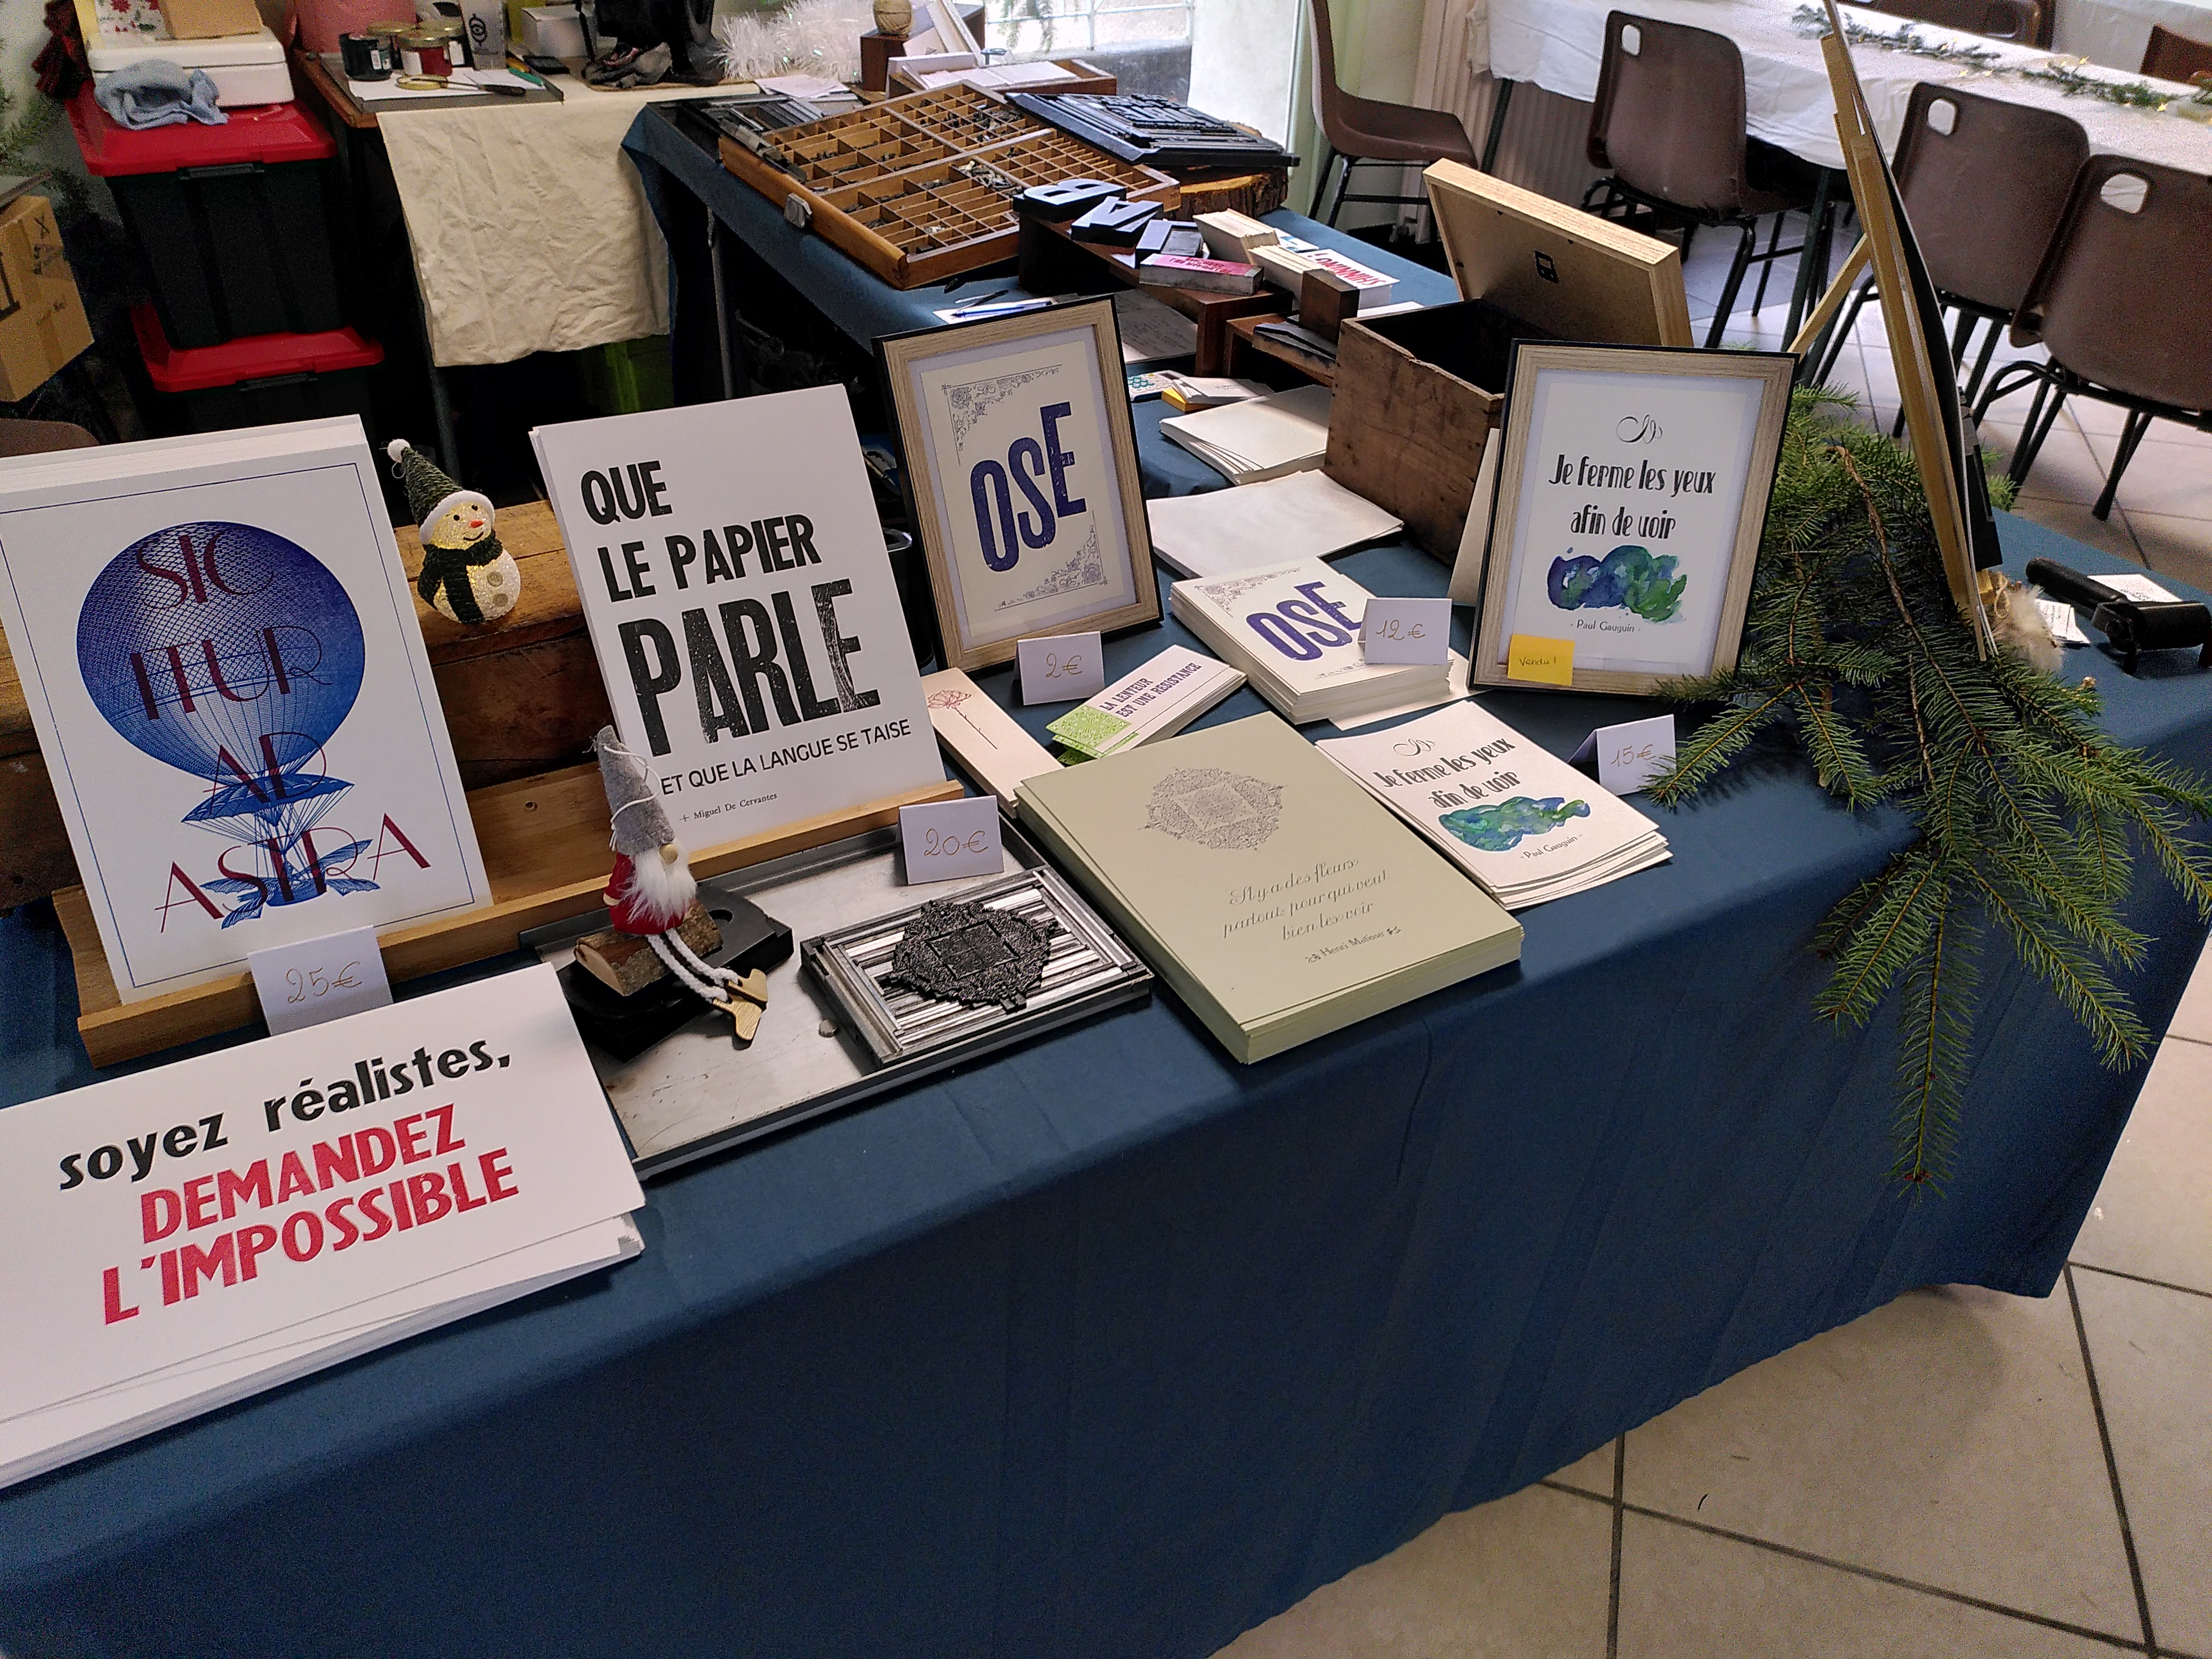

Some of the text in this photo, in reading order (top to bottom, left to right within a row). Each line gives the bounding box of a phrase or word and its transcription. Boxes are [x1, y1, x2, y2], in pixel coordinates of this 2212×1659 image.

[581, 460, 673, 525] QUE
[971, 401, 1087, 572] OSE
[1548, 453, 1717, 498] Je ferme les yeux
[1570, 504, 1676, 540] afin de voir
[135, 526, 276, 609] SIC
[597, 514, 822, 602] LE PAPIER
[1246, 581, 1362, 661] OSE
[1576, 619, 1635, 634] Paul Gauguin
[129, 625, 332, 721] ITUR
[617, 578, 881, 757] PARLE
[1519, 656, 1550, 666] Vendu
[1098, 677, 1154, 711] LA LENTEUR
[1114, 662, 1203, 718] EST UNE RESISTANCE
[203, 731, 327, 816] AD
[661, 718, 911, 795] ET QUE LA LANGUE SE TAISE
[1372, 738, 1516, 787] Je ferme les yeux
[693, 792, 778, 820] Miguel De Cervantes
[1427, 771, 1521, 808] afin de voir
[154, 812, 431, 933] ASTRA
[1523, 836, 1578, 859] Paul Gauguin
[1257, 890, 1269, 902] y
[1270, 883, 1283, 894] a
[1285, 872, 1312, 889] des
[1313, 859, 1359, 883] fleurs
[1289, 893, 1326, 917] pour
[1327, 883, 1354, 902] qui
[1356, 869, 1389, 890] veut
[1282, 902, 1374, 940] bien les voir
[1319, 930, 1385, 957] Henri Matisse
[60, 1037, 513, 1191] soyez réalistes,
[140, 1103, 466, 1244] DEMANDEZ
[103, 1146, 520, 1326] L'IMPOSSIBLE
